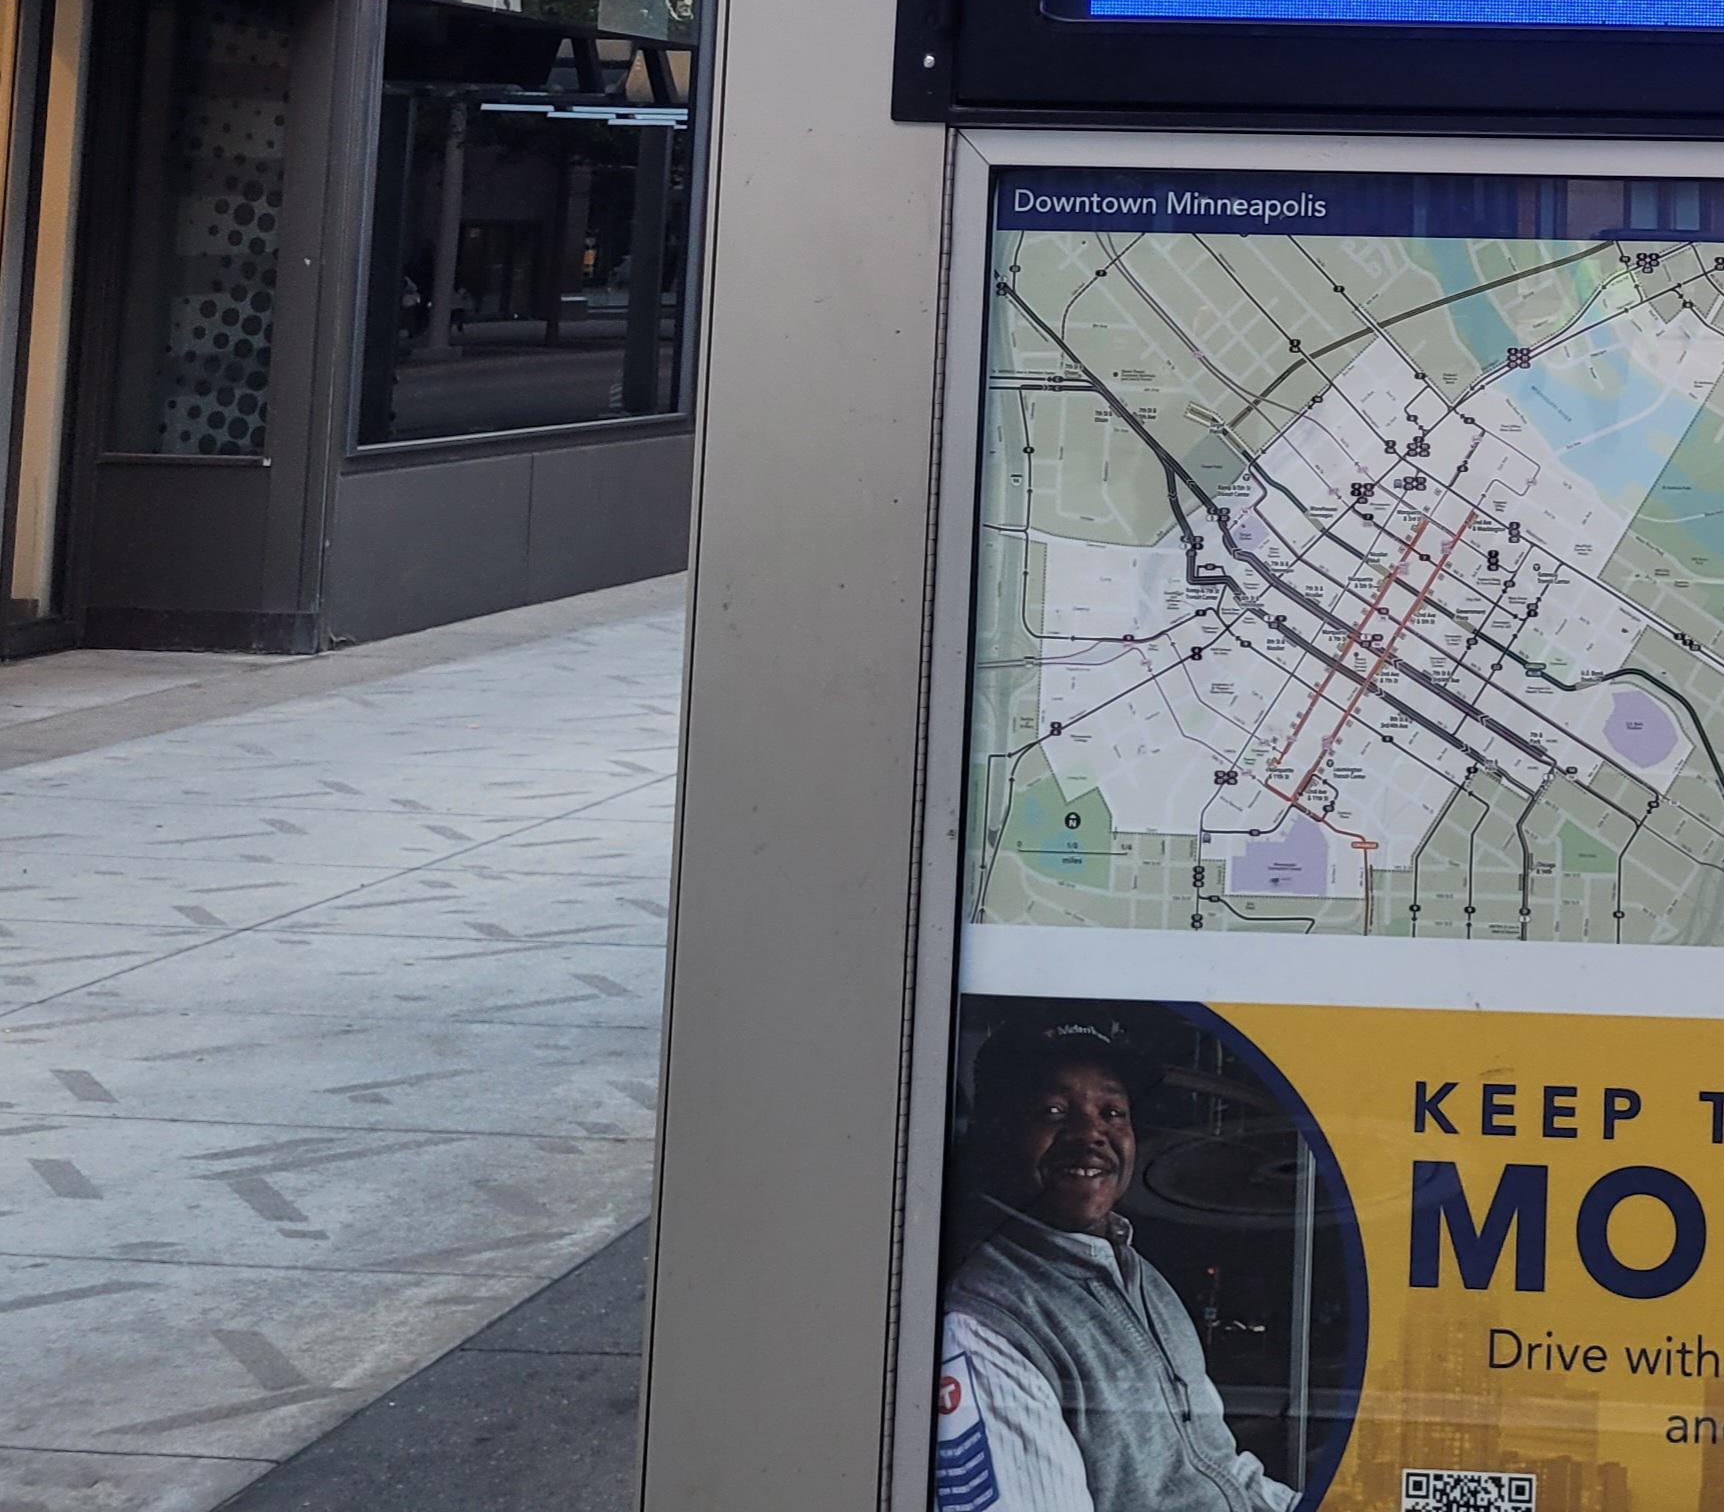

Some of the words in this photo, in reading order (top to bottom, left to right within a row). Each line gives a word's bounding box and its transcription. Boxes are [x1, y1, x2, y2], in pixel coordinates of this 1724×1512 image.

[1015, 189, 1156, 213] Downtown
[1168, 192, 1325, 224] Minneapolis
[1414, 1081, 1640, 1139] KEEP
[1489, 1329, 1606, 1372] Drive
[1626, 1334, 1718, 1377] with
